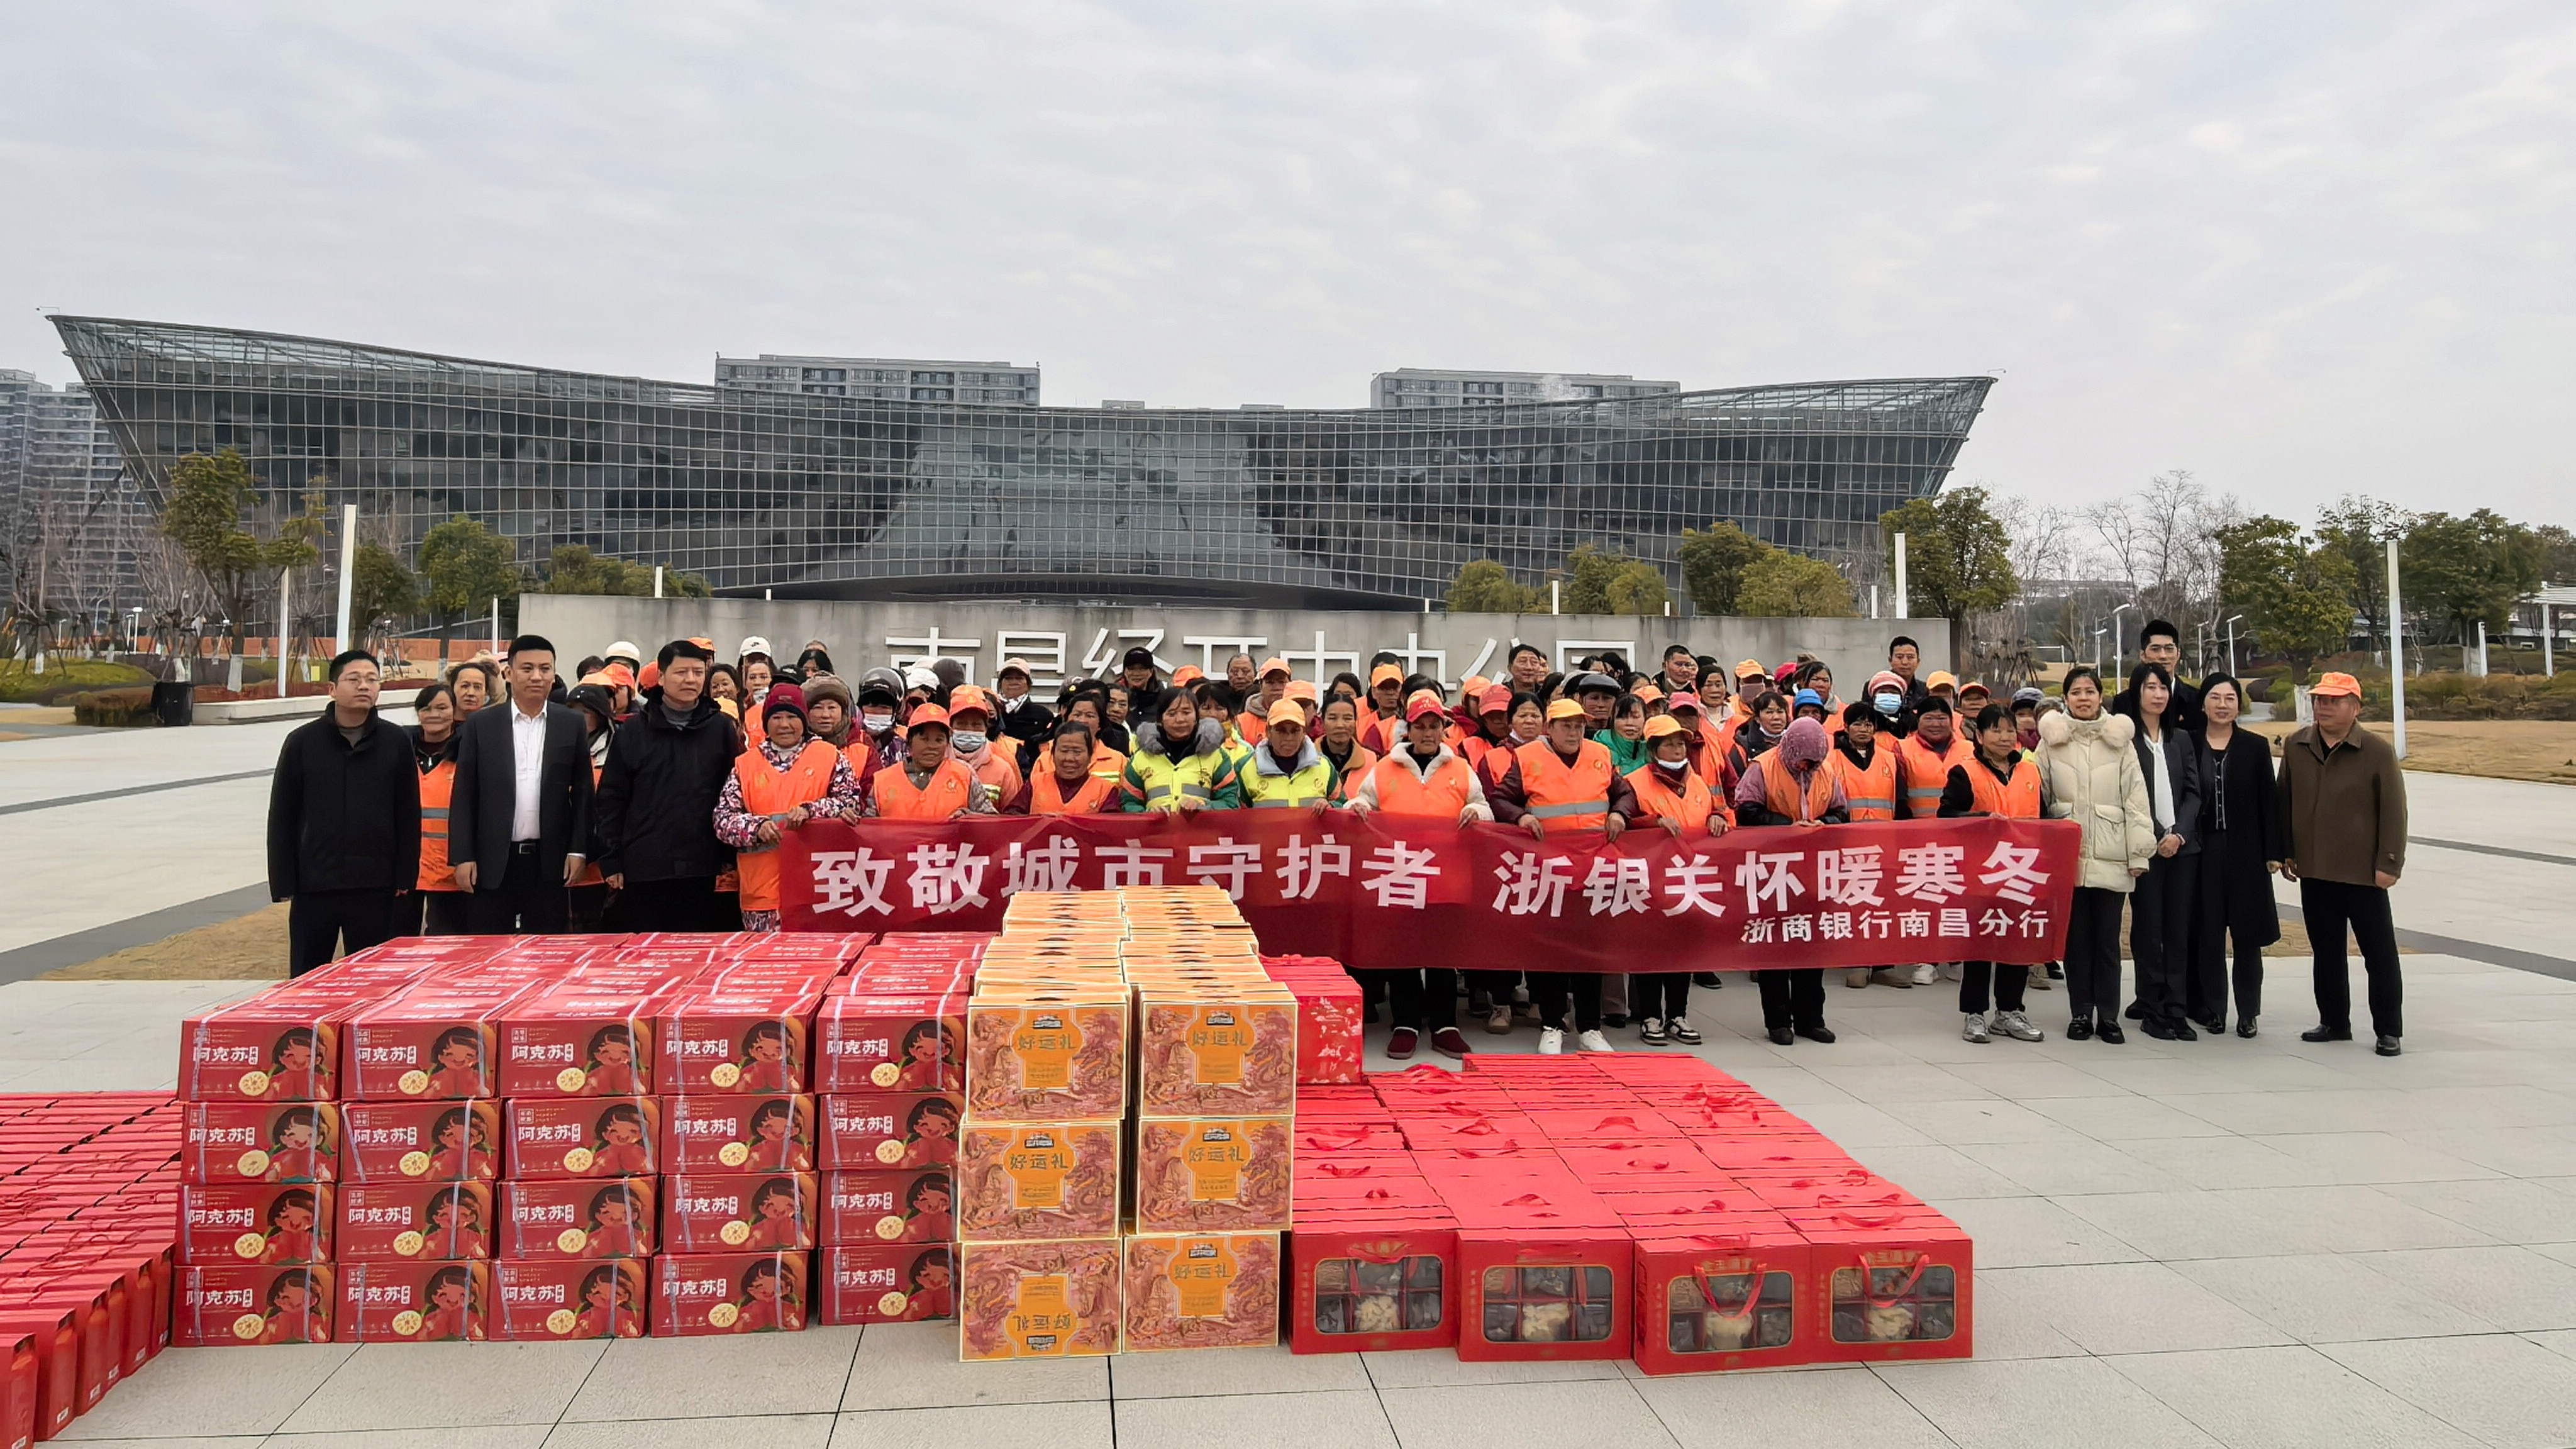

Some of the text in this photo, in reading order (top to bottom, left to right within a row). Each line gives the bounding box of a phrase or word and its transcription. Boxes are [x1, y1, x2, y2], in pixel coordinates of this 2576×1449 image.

[811, 835, 2050, 918] 致敬城市守护者 浙银关怀暖寒冬
[1741, 908, 2050, 943] 浙商银行南昌分行
[511, 1045, 564, 1060] 阿克苏
[518, 1124, 572, 1141] 阿克苏
[830, 1117, 882, 1133] 阿克苏
[354, 1128, 407, 1144] 阿克苏
[189, 1208, 245, 1224] 阿克苏
[348, 1208, 401, 1224] 阿克苏
[348, 1287, 401, 1302] 阿克苏
[501, 1286, 555, 1302] 阿克苏
